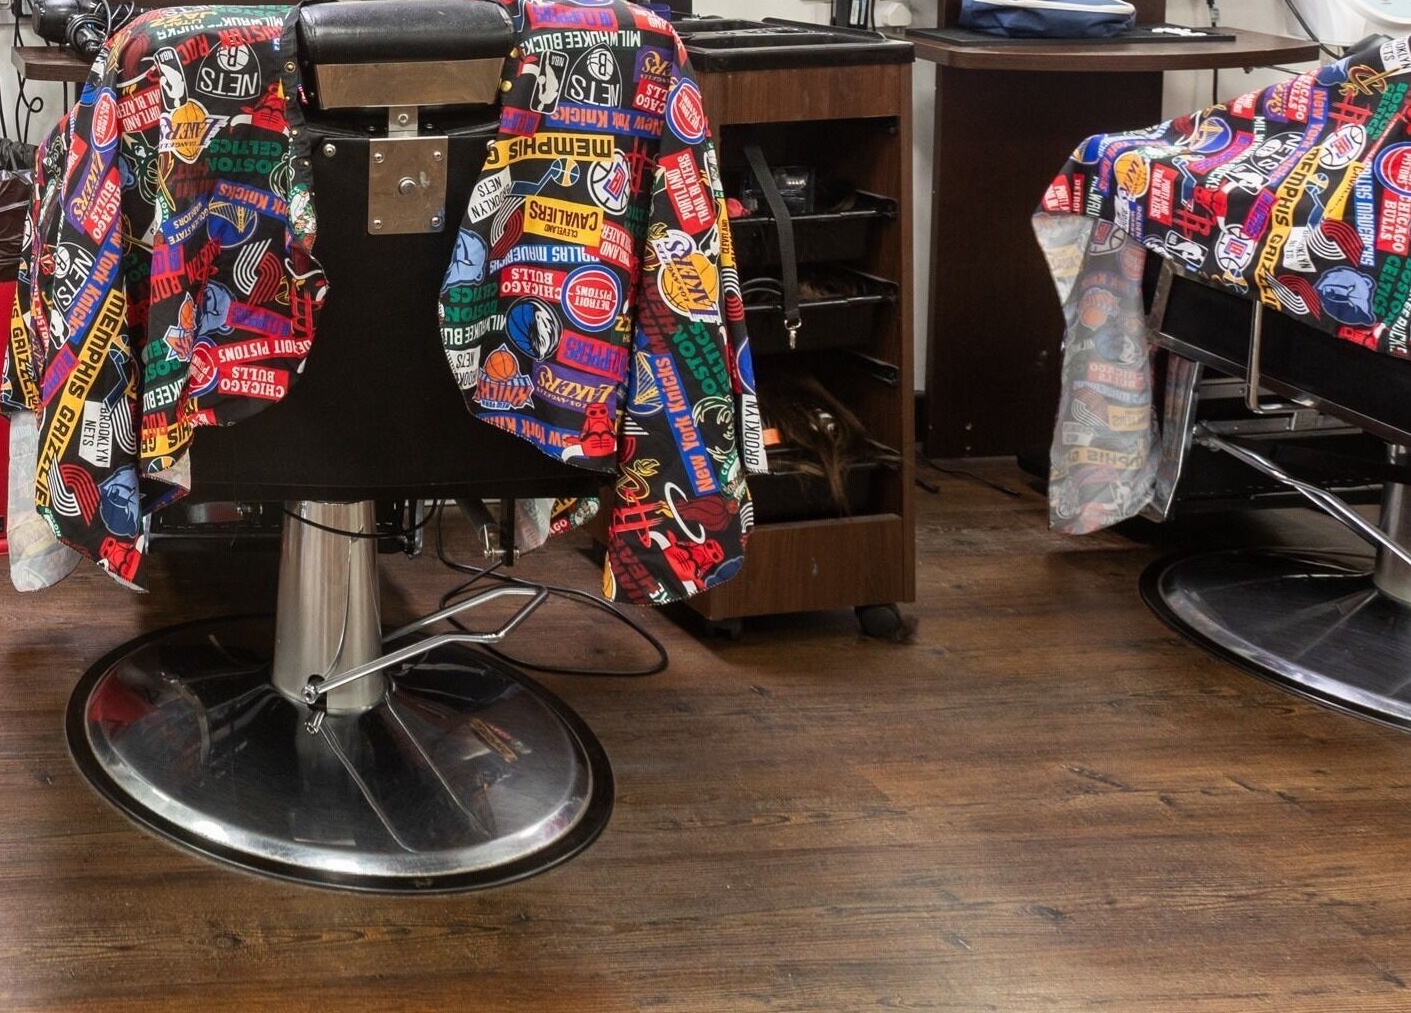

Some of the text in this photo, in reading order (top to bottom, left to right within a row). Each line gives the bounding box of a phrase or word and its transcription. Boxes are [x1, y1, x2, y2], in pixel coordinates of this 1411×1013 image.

[565, 29, 641, 52] MILWAUKEE
[157, 50, 174, 63] NBA
[551, 55, 565, 69] NBA
[199, 68, 258, 97] NETS
[571, 74, 620, 107] NETS
[550, 107, 609, 130] Knicks
[1312, 90, 1327, 120] New
[634, 115, 663, 136] New
[510, 136, 612, 159] MEMPHIS
[1257, 133, 1301, 175] NETS
[217, 183, 269, 211] Knicks
[477, 176, 502, 198] NETS
[666, 168, 696, 223] PORTLAND
[678, 152, 710, 223] TRAIL BLAZERS
[1274, 148, 1319, 228] MEMPHIS
[529, 201, 599, 230] CAVALIERS
[1380, 199, 1398, 241] BULLS
[544, 224, 579, 239] CLEVELAND
[55, 248, 93, 308] NETS
[502, 280, 563, 300] CHICAGO
[510, 268, 554, 284] BULLS
[664, 239, 719, 318] LAKERS
[574, 285, 612, 299] PISTONS
[575, 295, 610, 310] DETROIT
[67, 288, 102, 338] Knicks
[68, 288, 124, 399] MEMPHIS
[217, 340, 270, 363] PISTONS
[220, 378, 286, 398] CHICAGO
[231, 366, 276, 383] BULLS
[536, 365, 615, 405] LAKERS
[81, 418, 97, 448] NETS
[95, 405, 111, 465] BROOKLYN
[655, 356, 715, 492] New York Knicks
[743, 395, 761, 466] BROOKLYN
